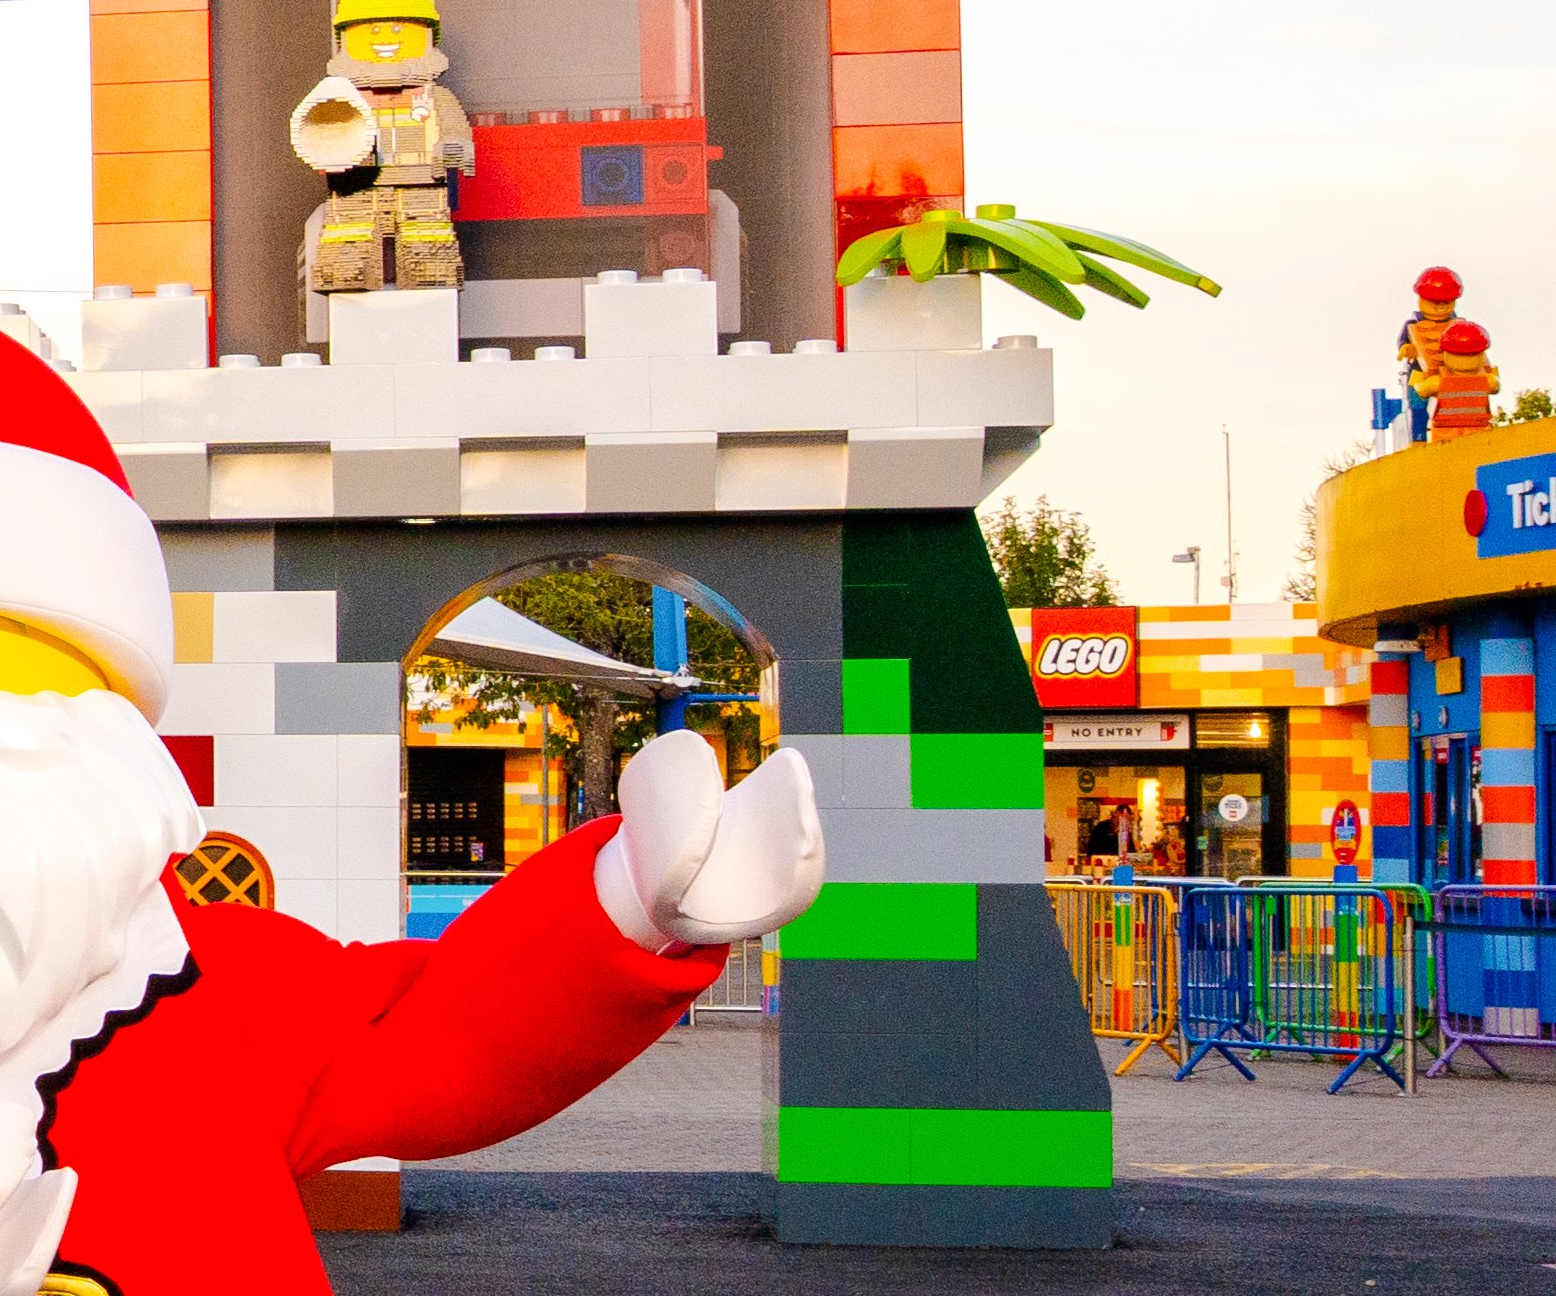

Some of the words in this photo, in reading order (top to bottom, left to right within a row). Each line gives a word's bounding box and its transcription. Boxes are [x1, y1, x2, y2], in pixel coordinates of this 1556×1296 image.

[1038, 636, 1129, 674] LEGO
[1071, 728, 1091, 737] NO
[1097, 727, 1143, 737] ENTRY
